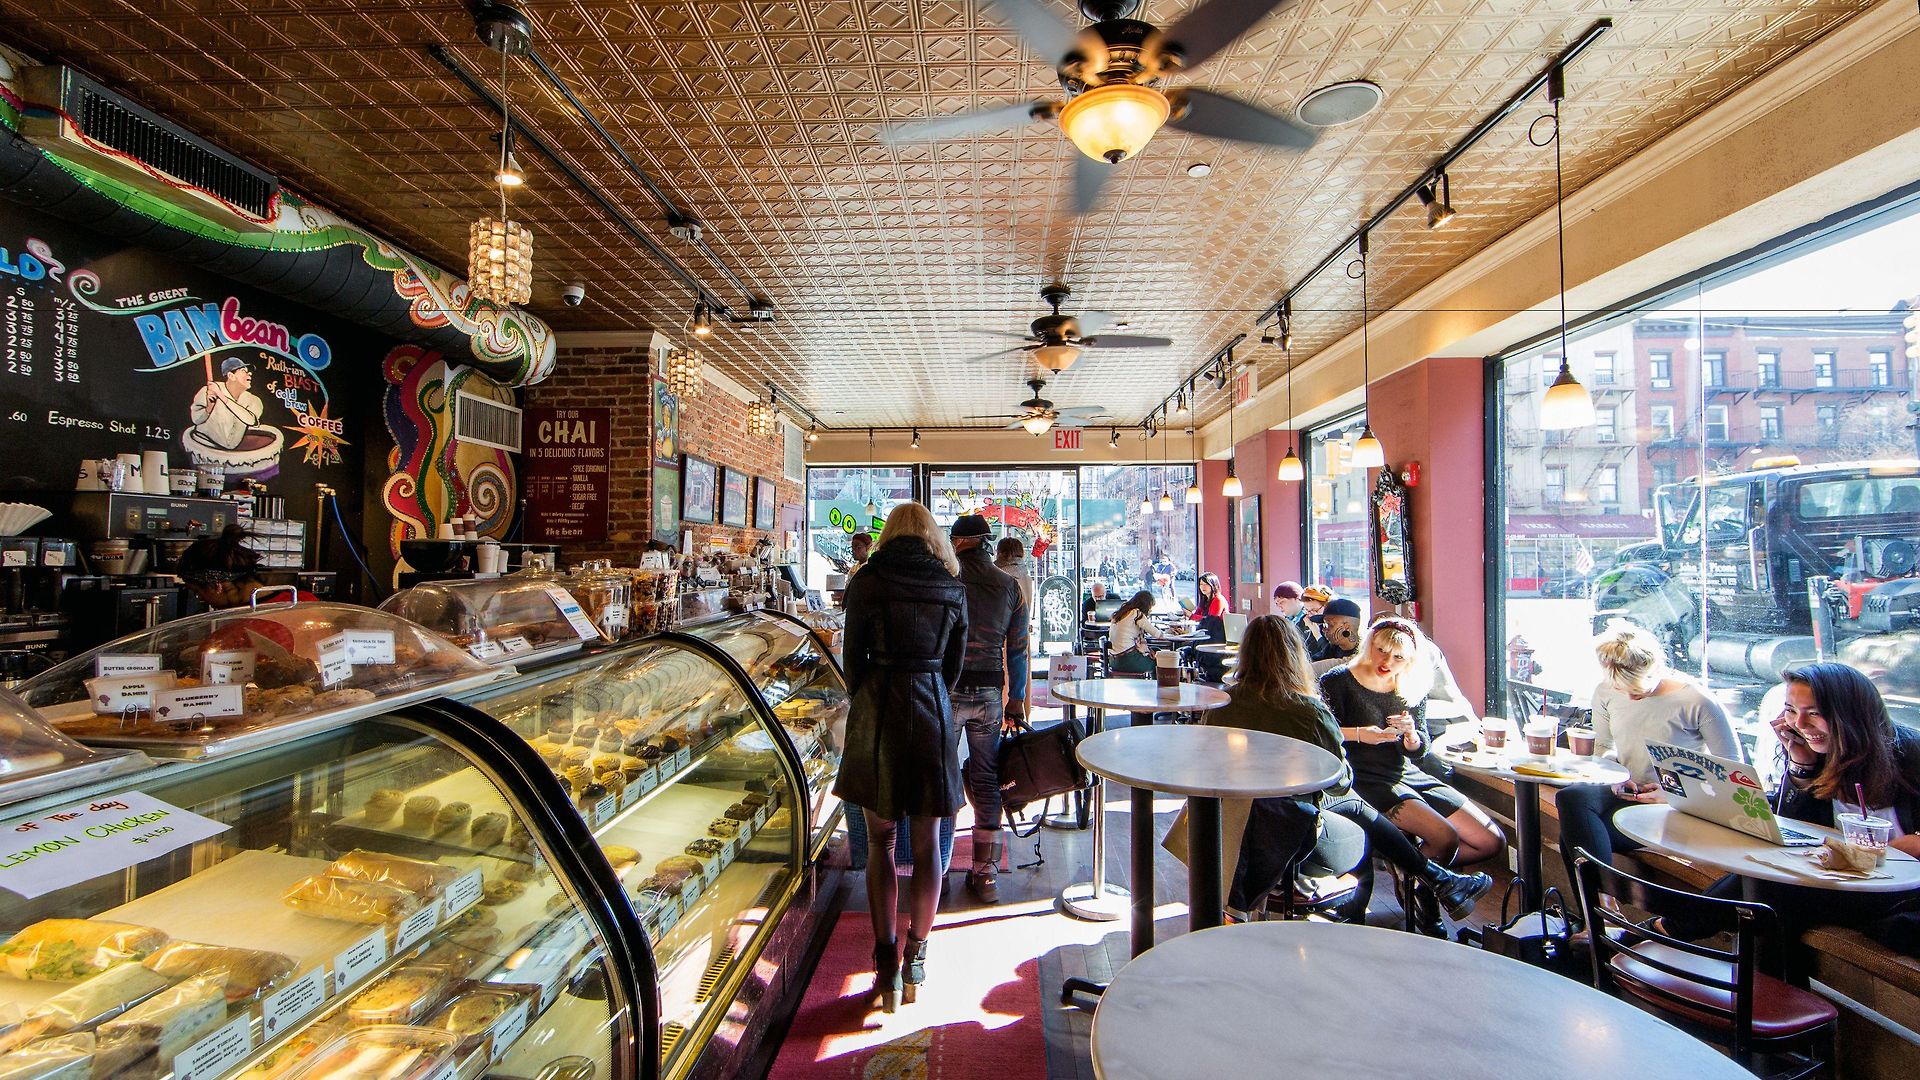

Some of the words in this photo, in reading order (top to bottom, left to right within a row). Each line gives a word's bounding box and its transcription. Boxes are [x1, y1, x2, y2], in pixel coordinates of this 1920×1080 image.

[115, 294, 145, 309] THE
[148, 287, 189, 303] GREAT
[267, 380, 278, 393] of
[283, 374, 321, 392] BLAST
[276, 388, 297, 401] cold
[285, 399, 307, 412] brew
[556, 410, 566, 419] TRY
[567, 410, 579, 419] OUR
[48, 410, 104, 430] Espresso
[109, 420, 136, 435] Shot
[145, 426, 171, 440] 1.25
[298, 412, 344, 434] COFFEE
[538, 420, 596, 444] CHAI
[1055, 430, 1081, 449] EXIT
[529, 447, 537, 458] IN
[538, 447, 543, 458] 5
[544, 447, 576, 458] DELICIOUS
[577, 448, 605, 458] FLAVORS
[78, 468, 88, 479] S
[130, 464, 142, 478] M
[160, 464, 168, 477] L
[586, 483, 594, 491] TEA
[587, 493, 598, 501] FREE
[561, 527, 583, 536] bean
[175, 694, 219, 702] BLUEBERRY
[1646, 744, 1727, 782] BILLABONG
[89, 799, 130, 811] day
[0, 835, 81, 868] LEMON
[192, 1047, 216, 1065] SMOKED
[217, 1033, 239, 1050] TURKEY
